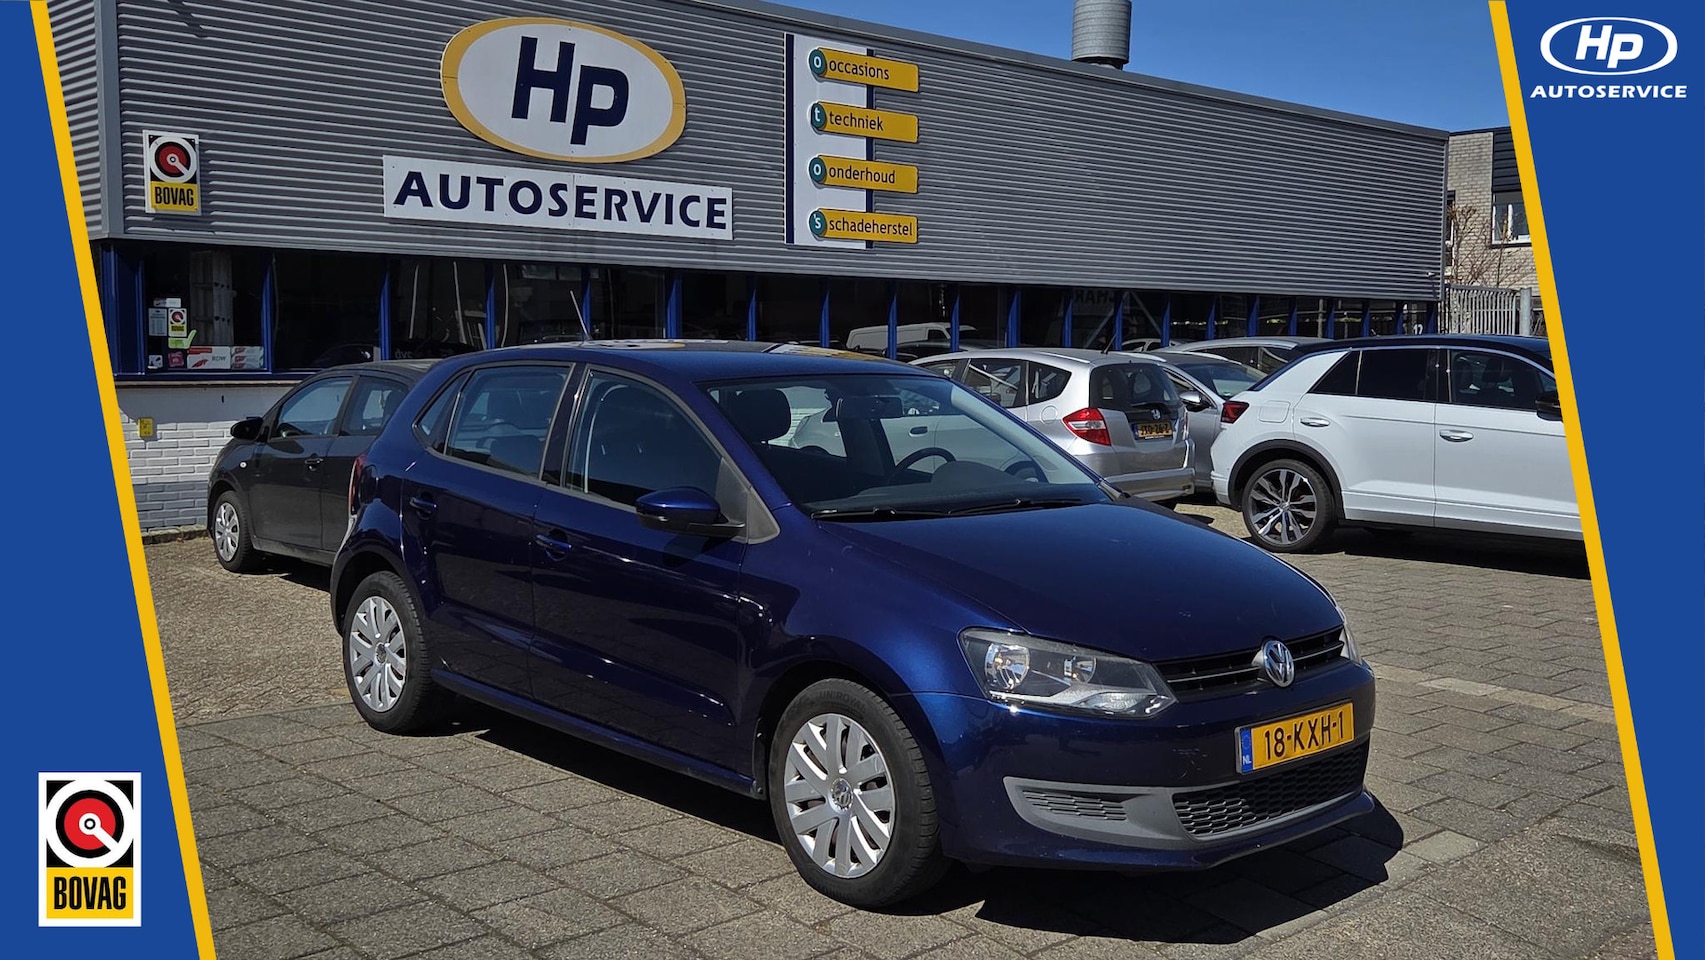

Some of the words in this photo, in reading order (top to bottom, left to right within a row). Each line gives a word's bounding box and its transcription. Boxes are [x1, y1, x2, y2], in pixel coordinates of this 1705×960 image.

[828, 59, 890, 80] occasions
[828, 111, 884, 131] techniek
[828, 164, 896, 184] onderhoud
[154, 186, 194, 207] BOVAG
[392, 170, 728, 230] AUTOSERVICE
[828, 216, 913, 236] schadeherstel
[818, 690, 867, 713] UNIROYAL
[1242, 754, 1253, 766] NL
[1264, 711, 1344, 760] 18-KXH-1
